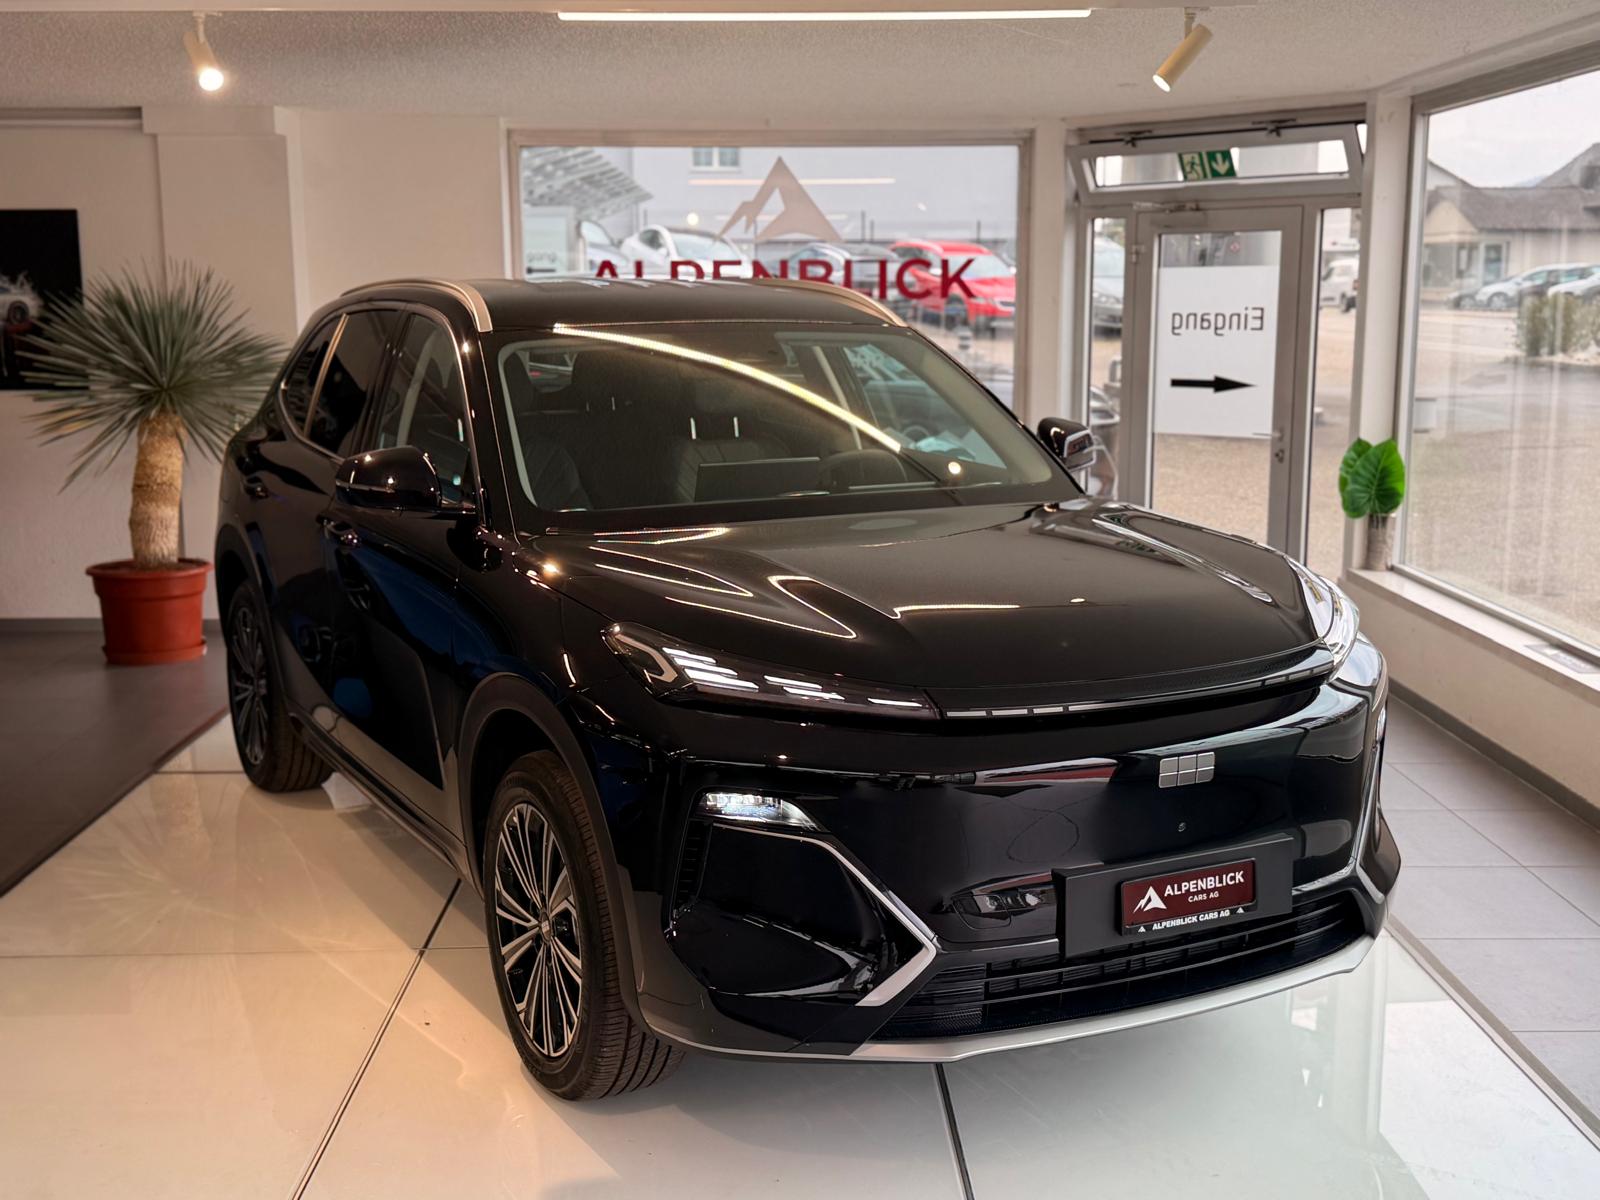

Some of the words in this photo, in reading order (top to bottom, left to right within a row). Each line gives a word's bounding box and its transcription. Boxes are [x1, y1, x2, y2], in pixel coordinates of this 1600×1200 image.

[1164, 870, 1244, 897] ALPENBLICK
[1188, 893, 1207, 903] CARS
[1209, 891, 1219, 899] AG
[1152, 917, 1198, 931] ALPENBLICK
[1199, 912, 1218, 921] CARS
[1220, 909, 1230, 918] AG
